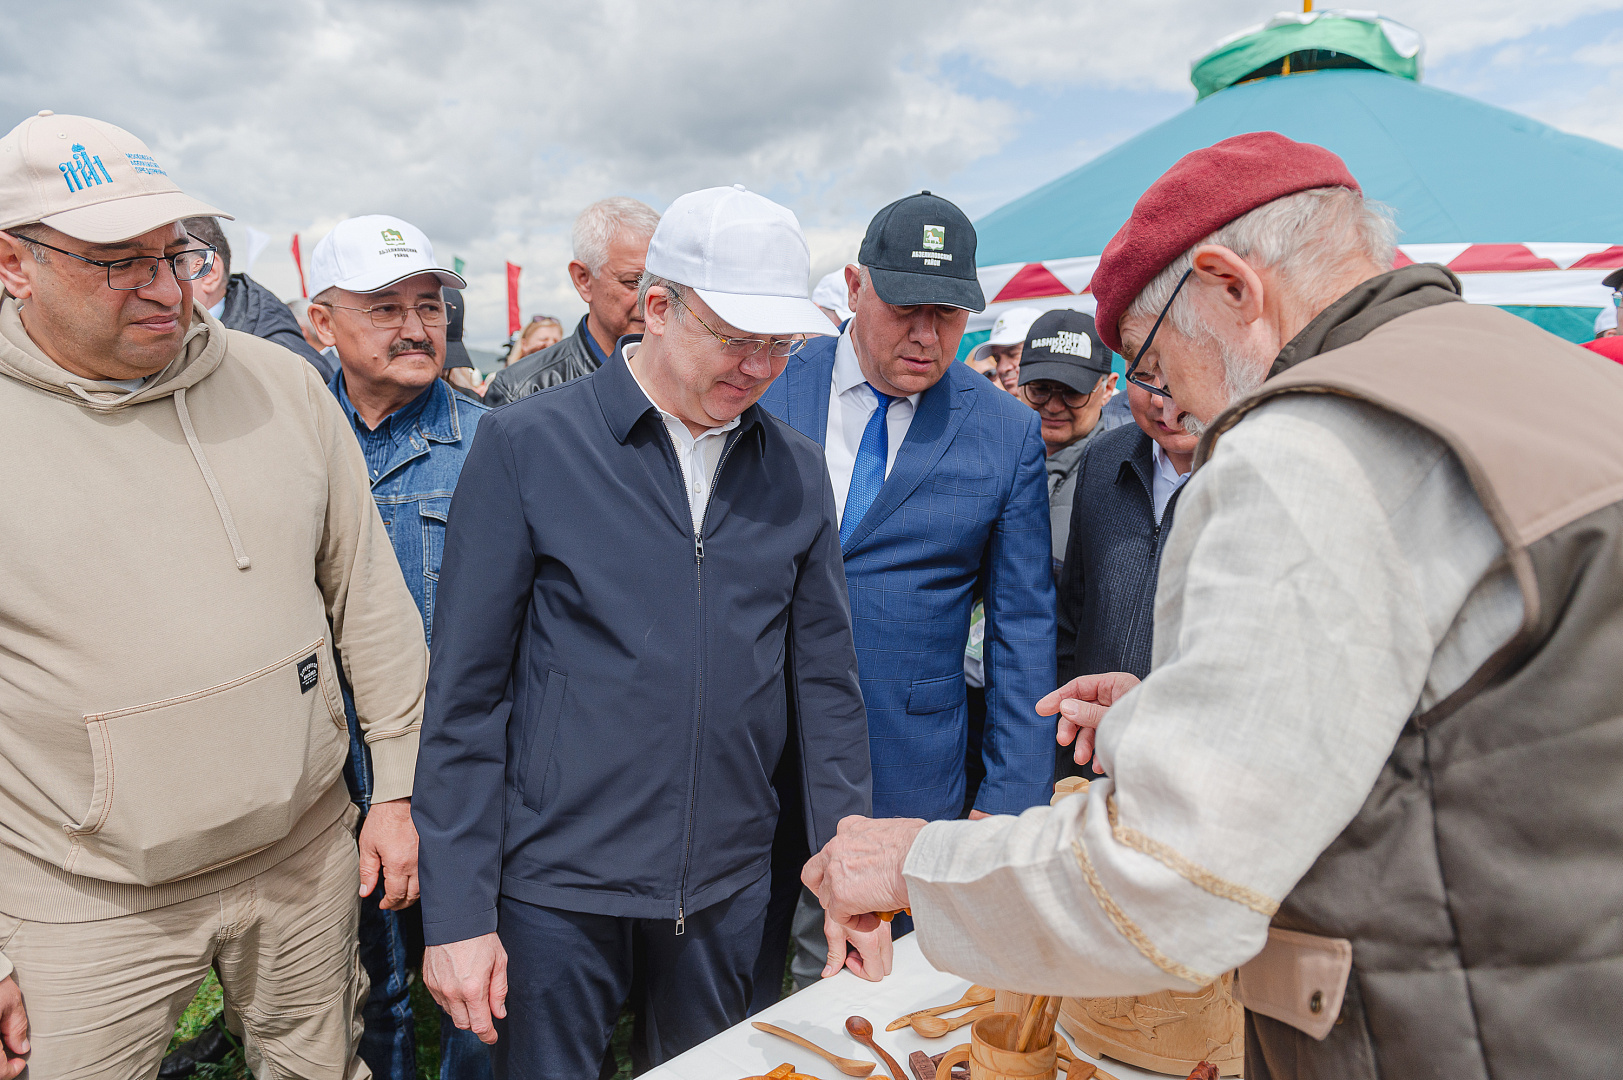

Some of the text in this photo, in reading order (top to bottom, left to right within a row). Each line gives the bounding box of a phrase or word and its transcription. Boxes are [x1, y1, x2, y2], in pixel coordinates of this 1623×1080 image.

[911, 250, 953, 262] АБЗЕЛИЛОВСКИЙ
[923, 258, 941, 267] РАЙОН
[1057, 330, 1081, 342] THE
[1031, 336, 1080, 349] BASHKORT
[1049, 345, 1080, 356] FACE
